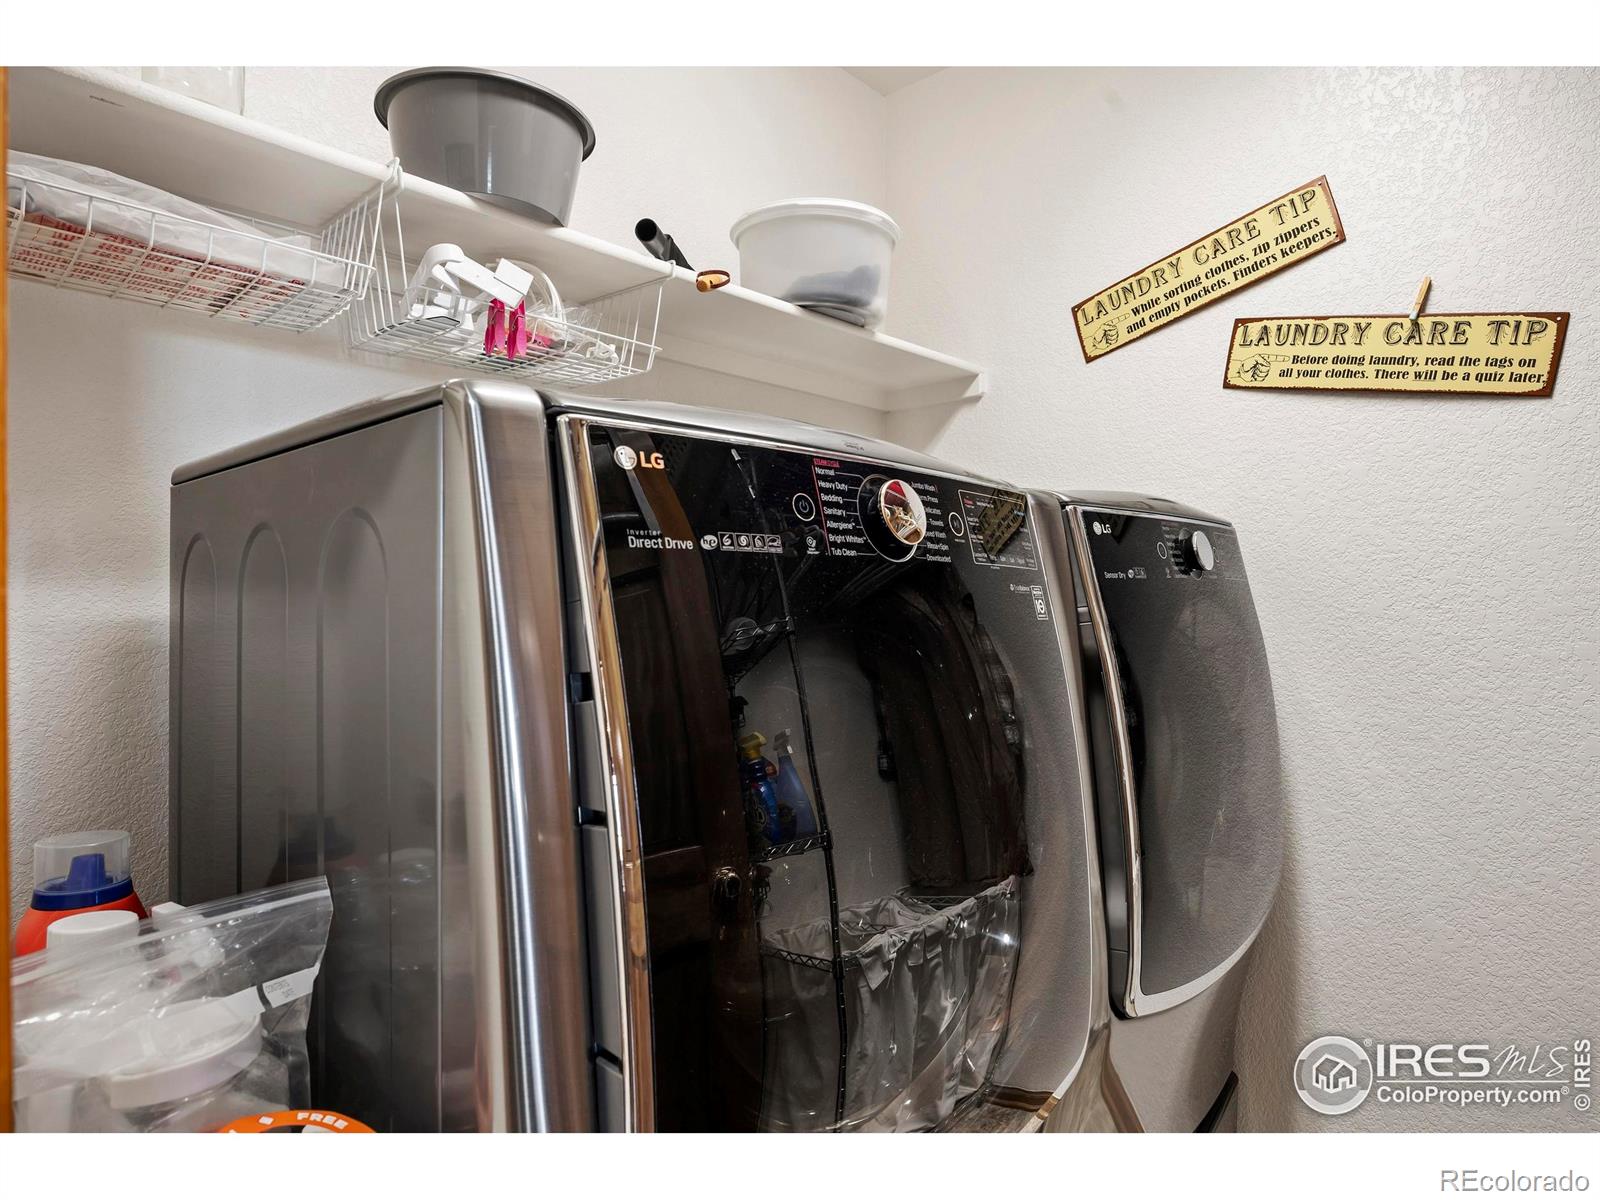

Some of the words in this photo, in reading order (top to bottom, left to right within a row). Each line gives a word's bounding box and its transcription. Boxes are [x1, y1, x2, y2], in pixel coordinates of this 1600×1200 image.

[1081, 256, 1184, 326] LAUNDRY
[1193, 217, 1262, 265] CARE
[1268, 189, 1316, 226] TIP
[1131, 295, 1161, 317] While
[1163, 274, 1202, 301] sorting
[1204, 253, 1249, 280] clothes,
[1252, 239, 1271, 257] zip
[1273, 217, 1320, 247] zippers
[1126, 318, 1146, 334] and
[1148, 303, 1182, 322] empty
[1184, 278, 1231, 307] pockets.
[1233, 253, 1278, 281] Finders
[1281, 227, 1336, 258] keepers.
[1239, 321, 1372, 347] LAUNDRY
[1383, 319, 1472, 346] CARE
[1487, 319, 1549, 346] TIP
[1291, 354, 1329, 366] Before
[1331, 354, 1366, 367] doing
[1368, 354, 1420, 368] laundry,
[1424, 355, 1455, 367] read
[1459, 355, 1481, 367] the
[1484, 356, 1514, 369] tags
[1518, 358, 1537, 368] on
[1278, 367, 1294, 378] all
[1296, 369, 1322, 380] your
[1325, 368, 1369, 380] clothes.
[1374, 368, 1410, 380] There
[1412, 369, 1438, 382] will
[1441, 370, 1459, 381] be
[1462, 372, 1471, 382] a
[1474, 371, 1505, 384] quiz
[1508, 371, 1547, 385] later.
[639, 451, 665, 469] LG
[818, 480, 837, 491] Heavy
[837, 482, 849, 492] Duty
[821, 493, 843, 504] Bedding
[626, 528, 662, 537] Inverter
[1102, 524, 1112, 534] LG
[628, 536, 663, 549] Direct
[664, 537, 694, 550] Drive
[831, 547, 842, 556] Tub
[842, 548, 857, 557] Clean
[297, 1112, 348, 1130] FREE
